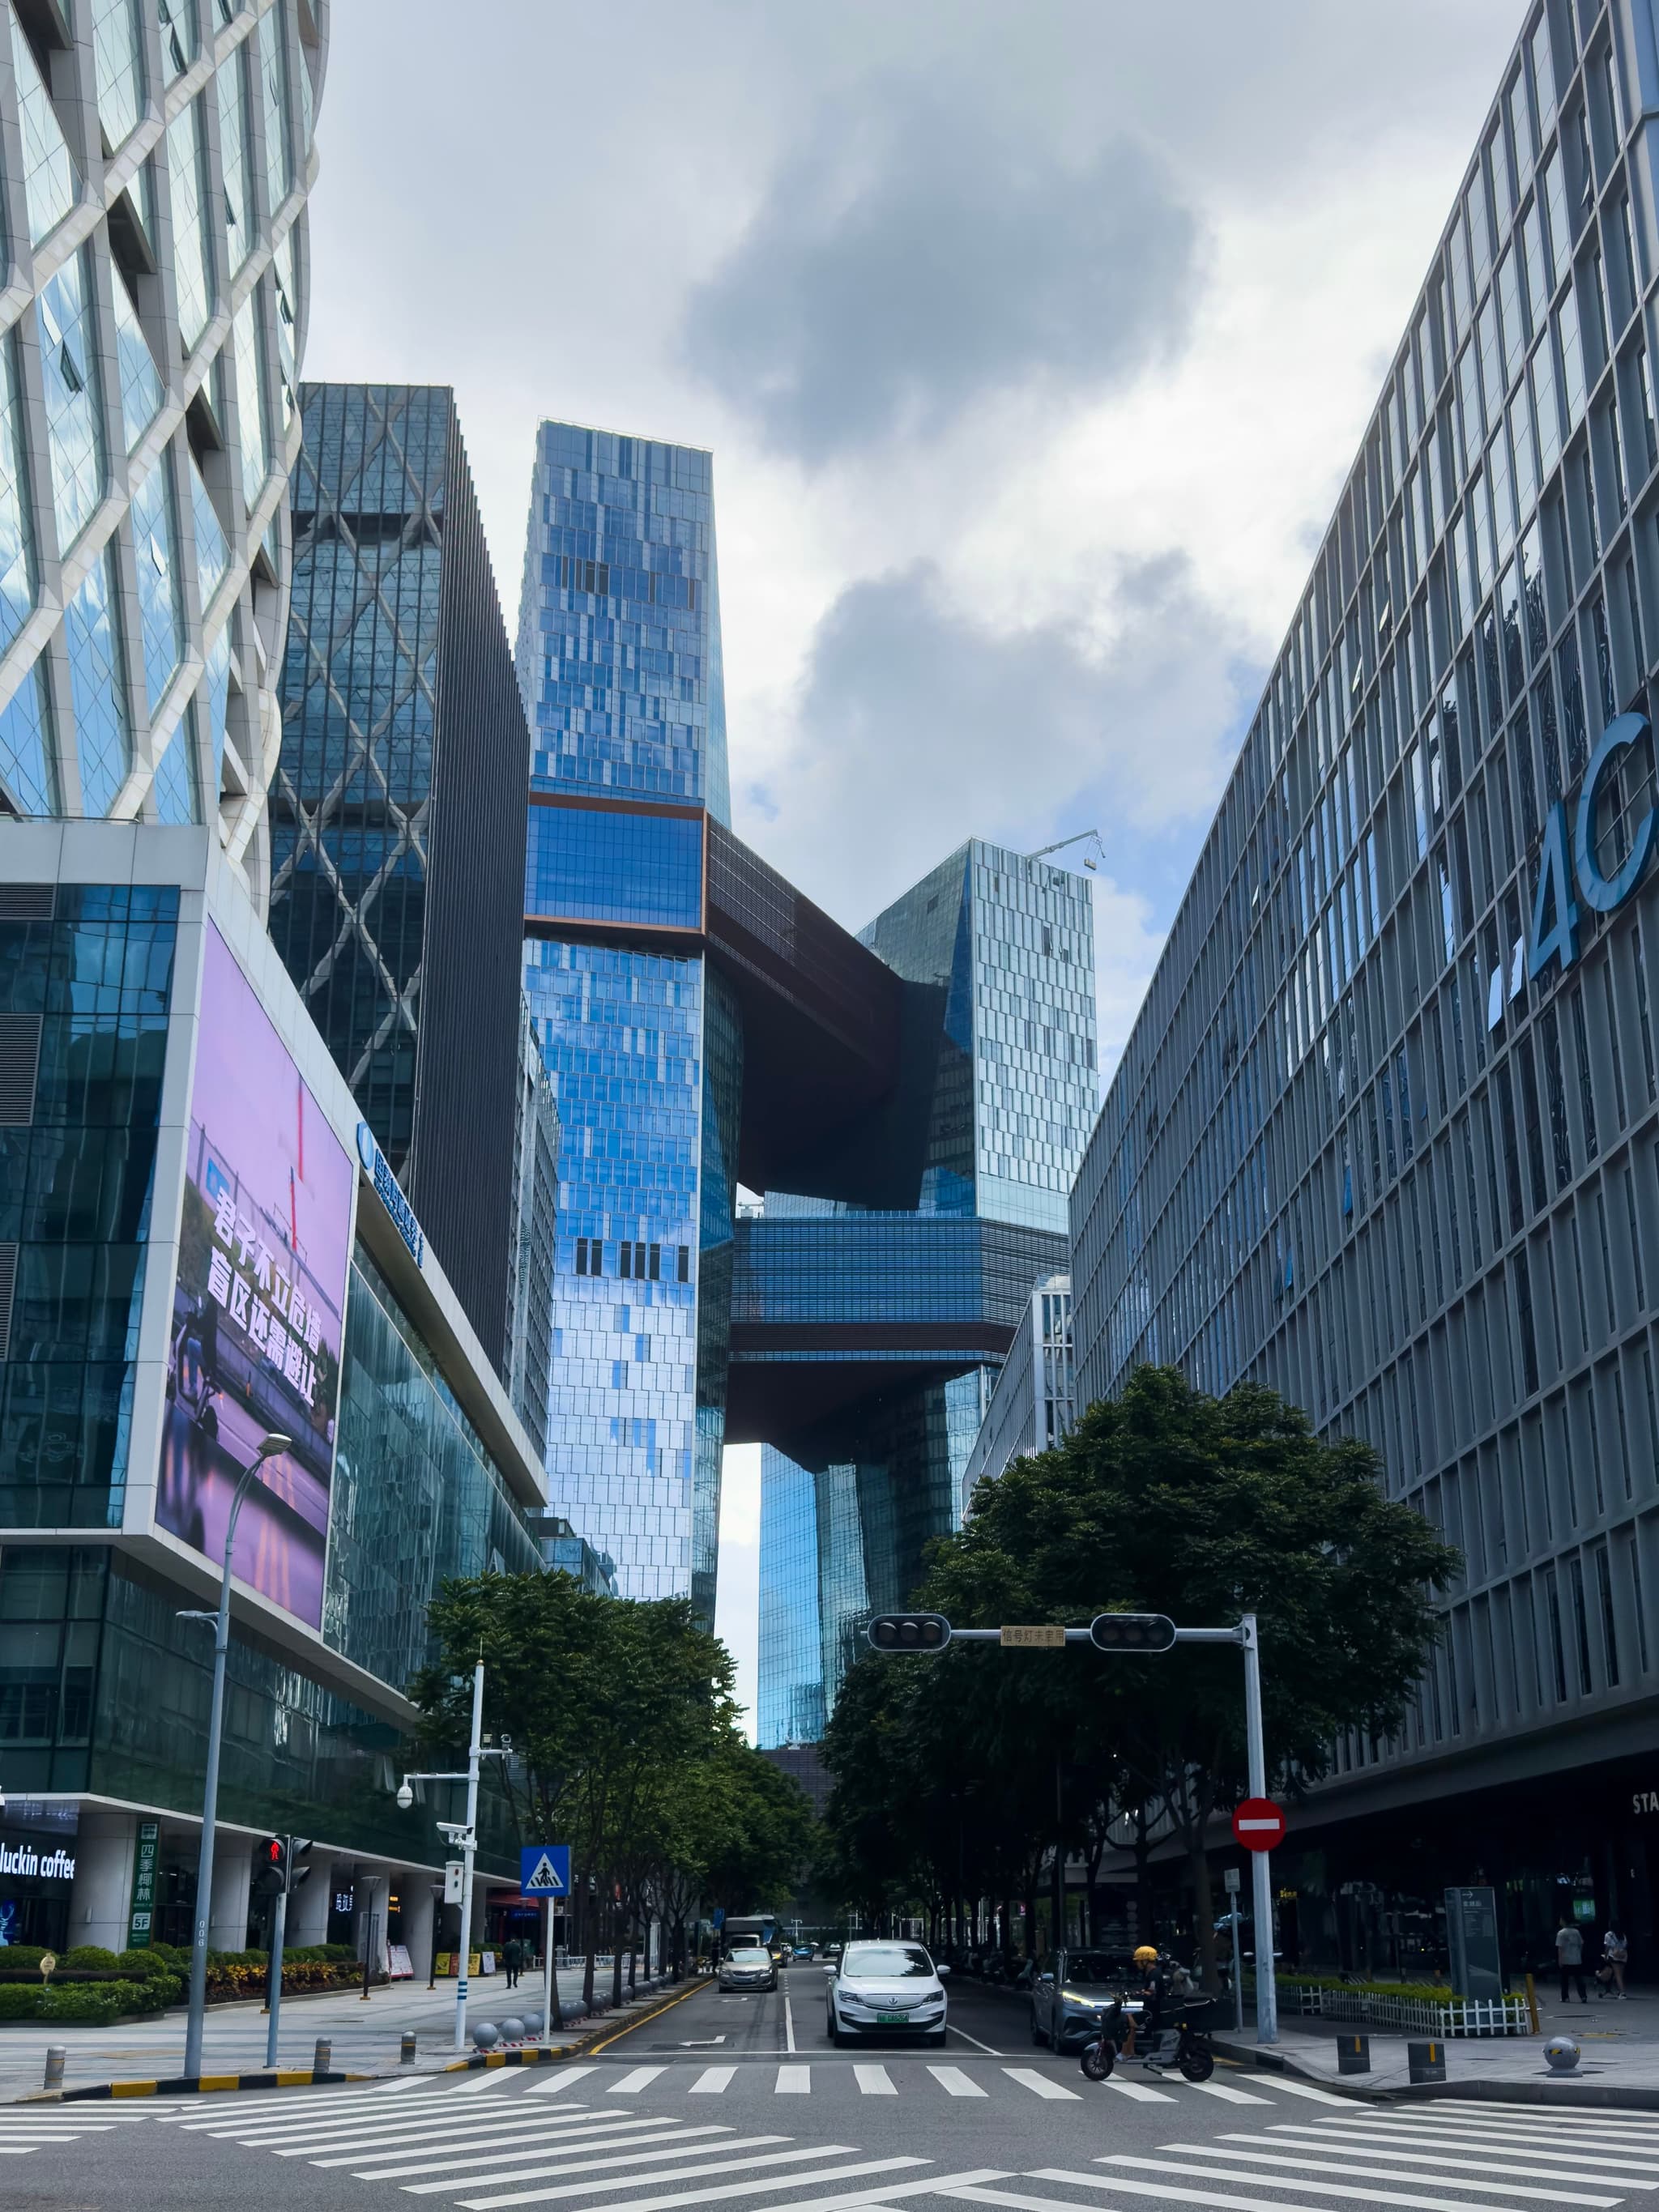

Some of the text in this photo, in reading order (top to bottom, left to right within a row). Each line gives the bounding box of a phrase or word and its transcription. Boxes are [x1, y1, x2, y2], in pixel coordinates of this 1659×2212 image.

[214, 1185, 322, 1356] 君子不立危墙
[207, 1245, 317, 1408] 盲区还需避让
[1632, 1791, 1659, 1814] STA
[0, 1843, 38, 1876] luckin
[137, 1844, 155, 1901] 四季椰林
[134, 1918, 148, 1928] 5F
